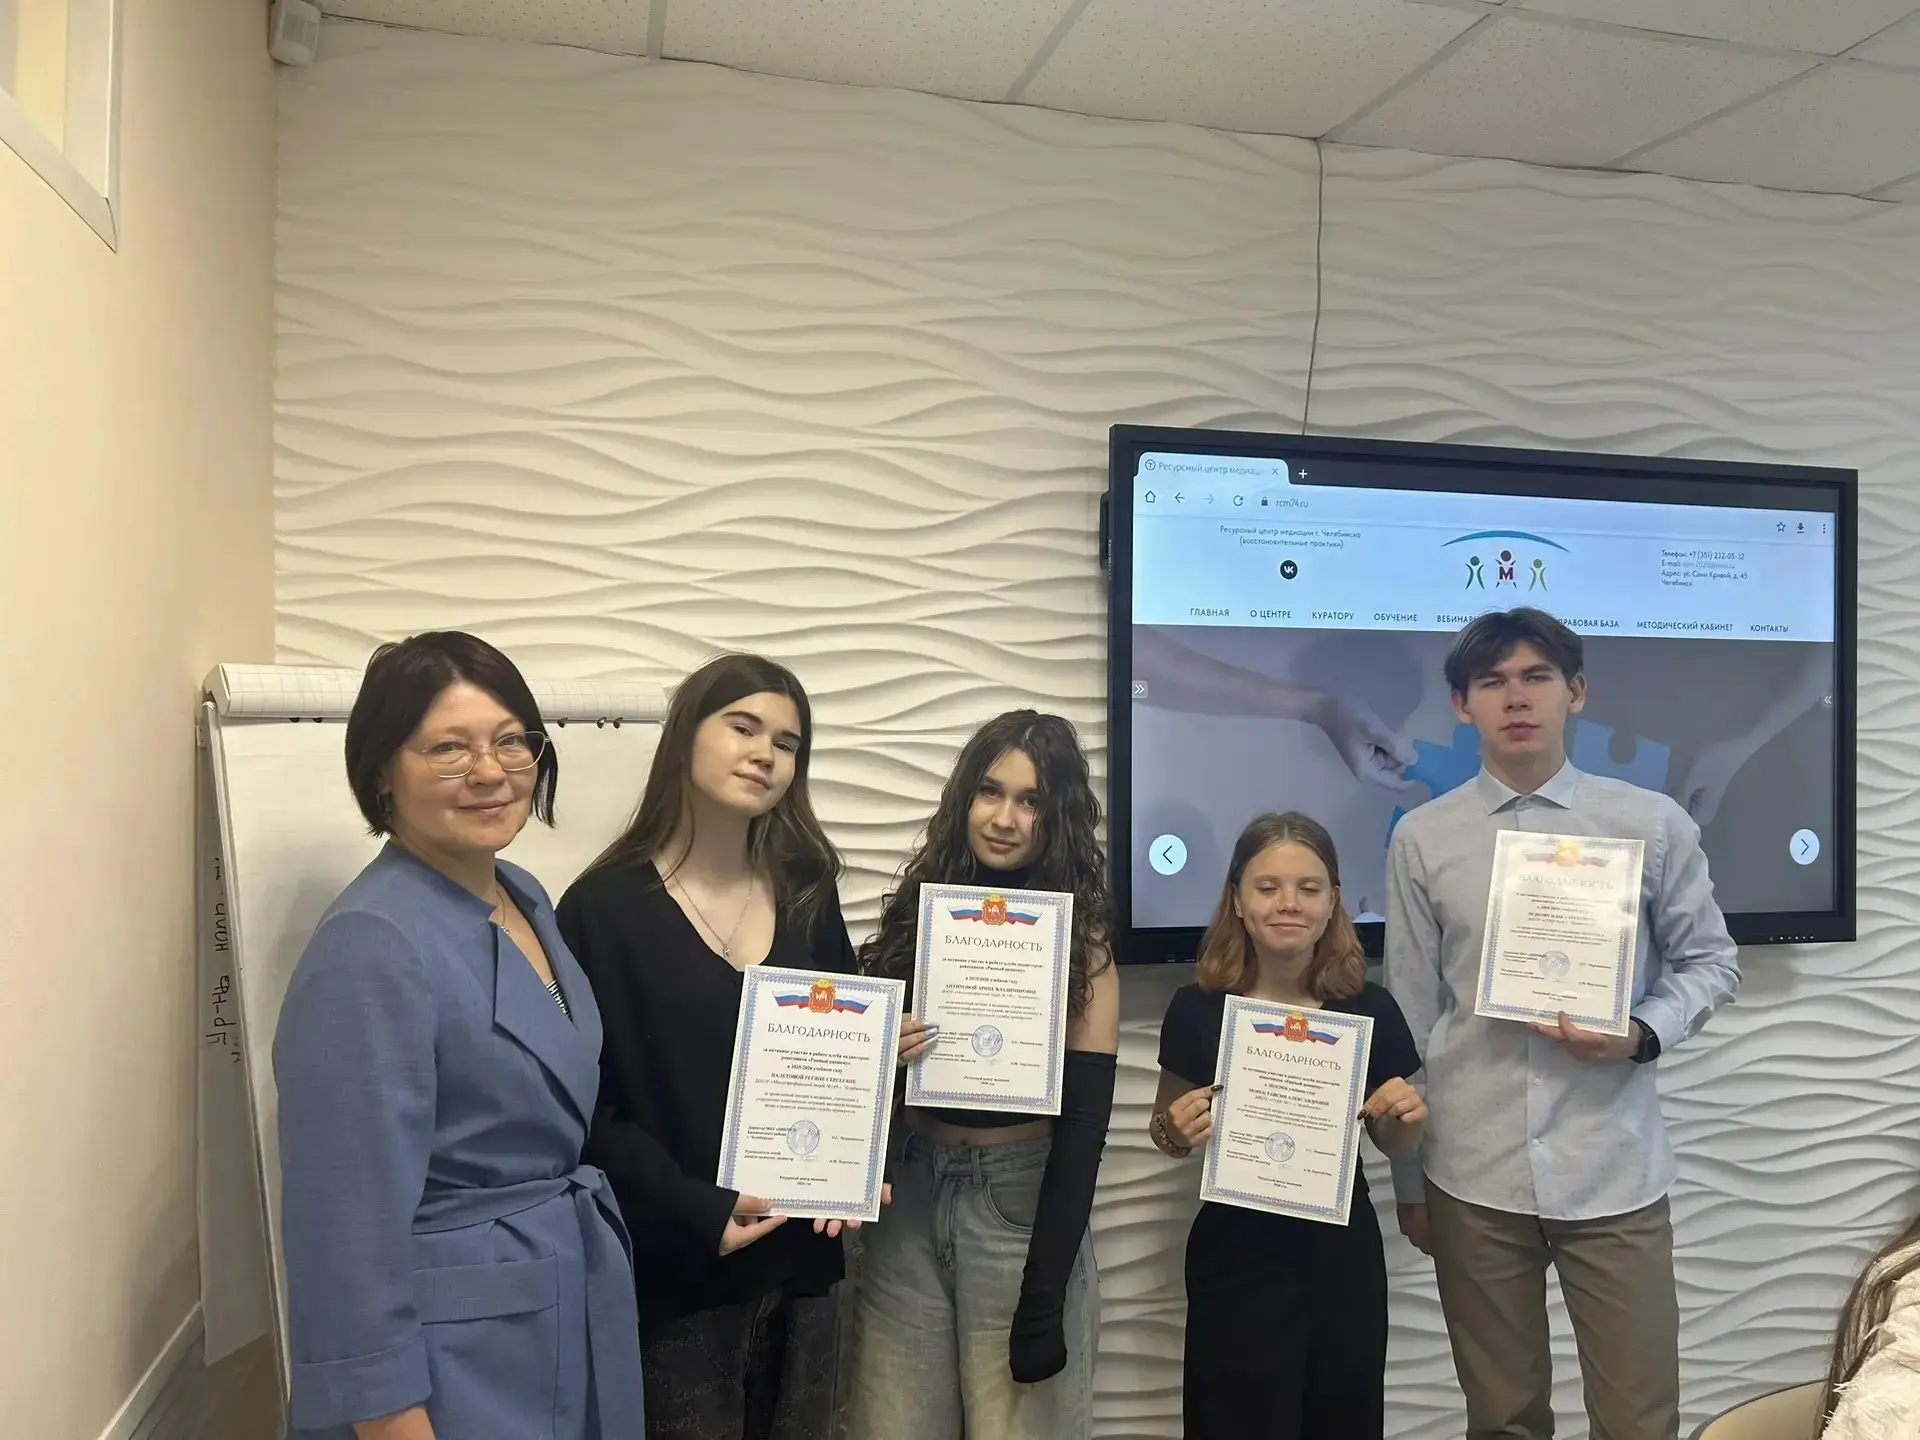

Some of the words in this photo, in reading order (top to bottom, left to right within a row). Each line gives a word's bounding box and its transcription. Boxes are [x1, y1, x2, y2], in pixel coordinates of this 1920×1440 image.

[1159, 461, 1202, 473] Ресурсный
[1204, 465, 1228, 475] центр
[1276, 499, 1308, 509] rcm74.ru
[1220, 525, 1256, 537] Ресурсный
[1258, 528, 1278, 537] центр
[1190, 608, 1230, 616] ГЛАВНАЯ
[1260, 610, 1291, 619] ЦЕНТРЕ
[1312, 611, 1354, 620] КУРАТОРУ
[1373, 613, 1418, 621] ОБУЧЕНИЕ
[1637, 621, 1698, 630] МЕТОДИЧЕСКИЙ
[1700, 623, 1733, 631] КАБИНЕТ
[945, 935, 1043, 952] БЛАГОДАРНОСТЬ
[767, 1022, 870, 1043] БЛАГОДАРНОСТЬ
[1246, 1046, 1341, 1071] БЛАГОДАРНОСТЬ
